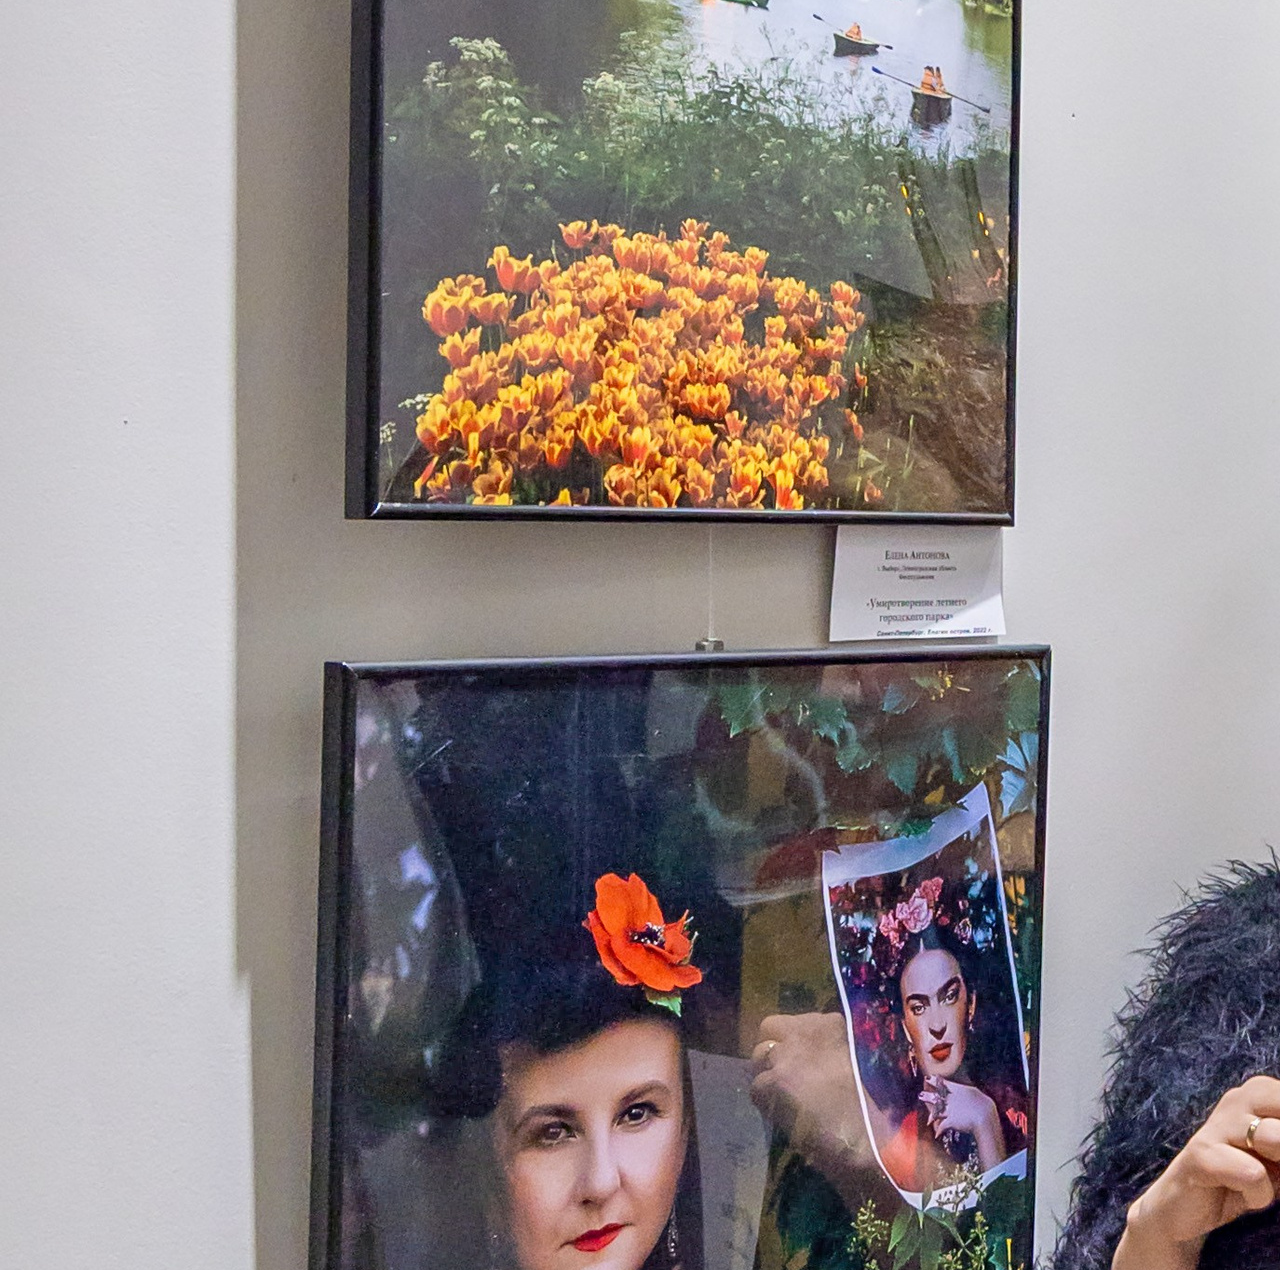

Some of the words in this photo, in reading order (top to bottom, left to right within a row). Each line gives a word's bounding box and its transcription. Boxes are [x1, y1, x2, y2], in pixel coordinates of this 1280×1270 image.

[910, 550, 950, 560] АНТОНОВА
[935, 599, 967, 607] летнего
[879, 613, 924, 625] городского
[925, 613, 954, 623] парка»
